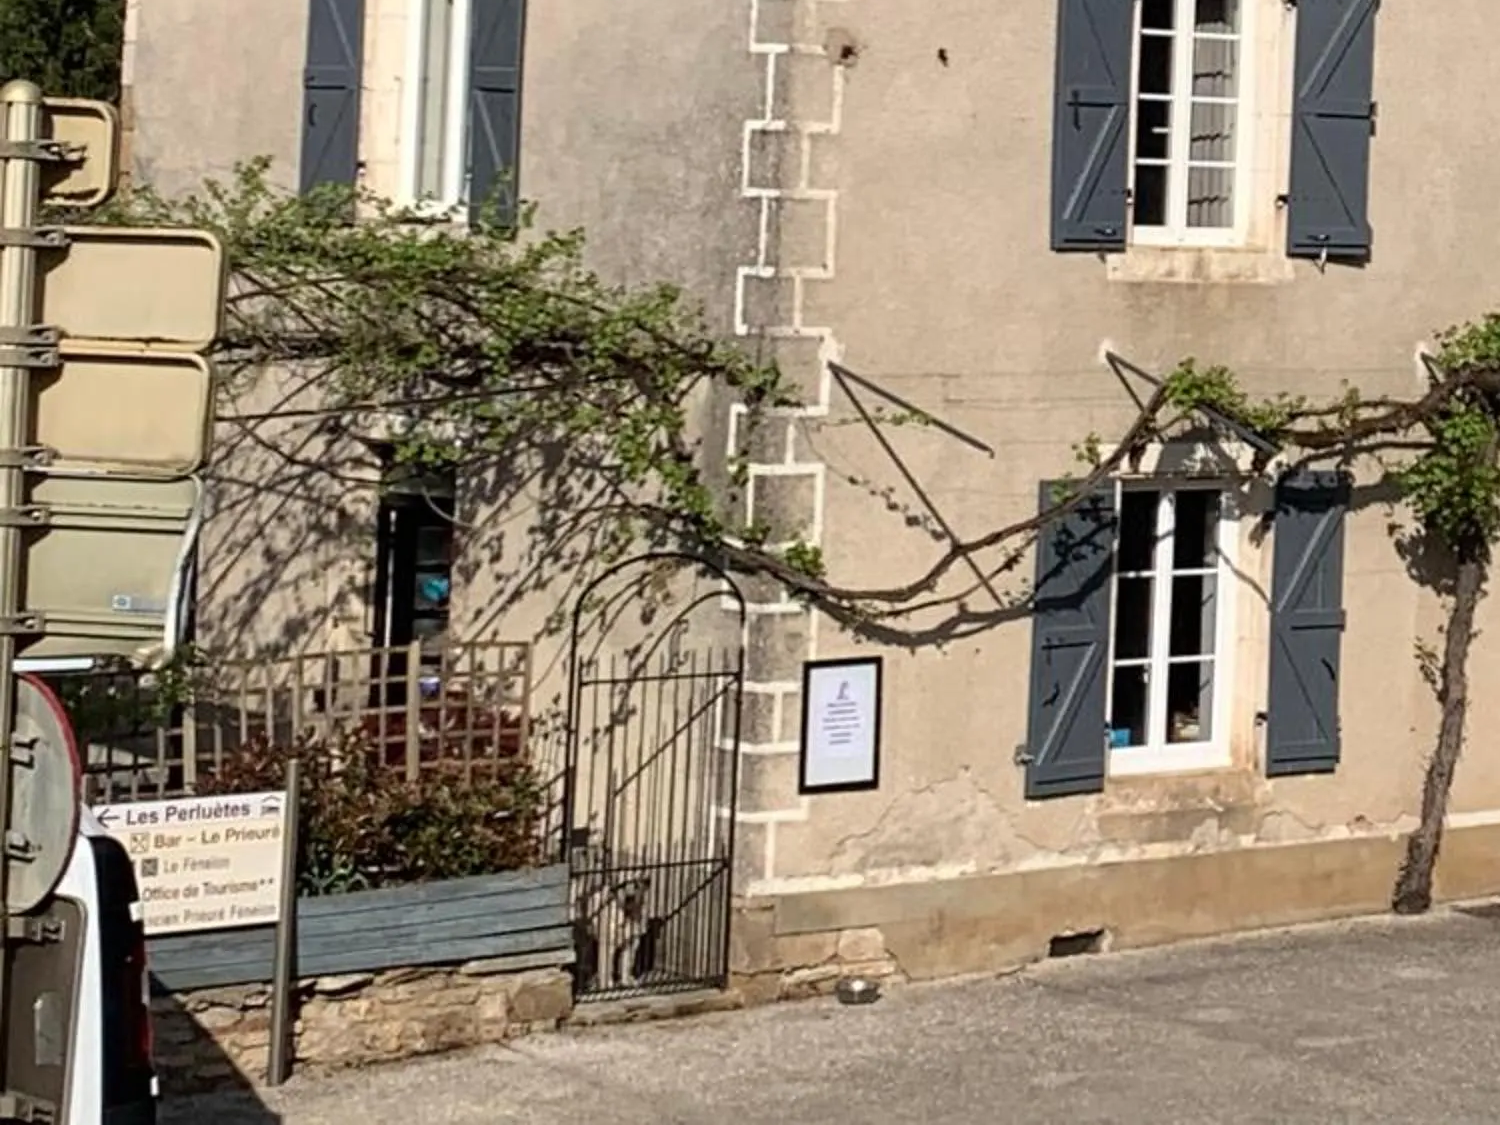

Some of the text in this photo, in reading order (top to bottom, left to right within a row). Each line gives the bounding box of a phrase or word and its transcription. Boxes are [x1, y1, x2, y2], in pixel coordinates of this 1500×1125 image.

[126, 809, 159, 826] Les
[154, 832, 182, 850] Bar
[202, 829, 221, 845] Le
[163, 858, 179, 873] Le
[142, 886, 180, 902] Office
[182, 883, 200, 899] de
